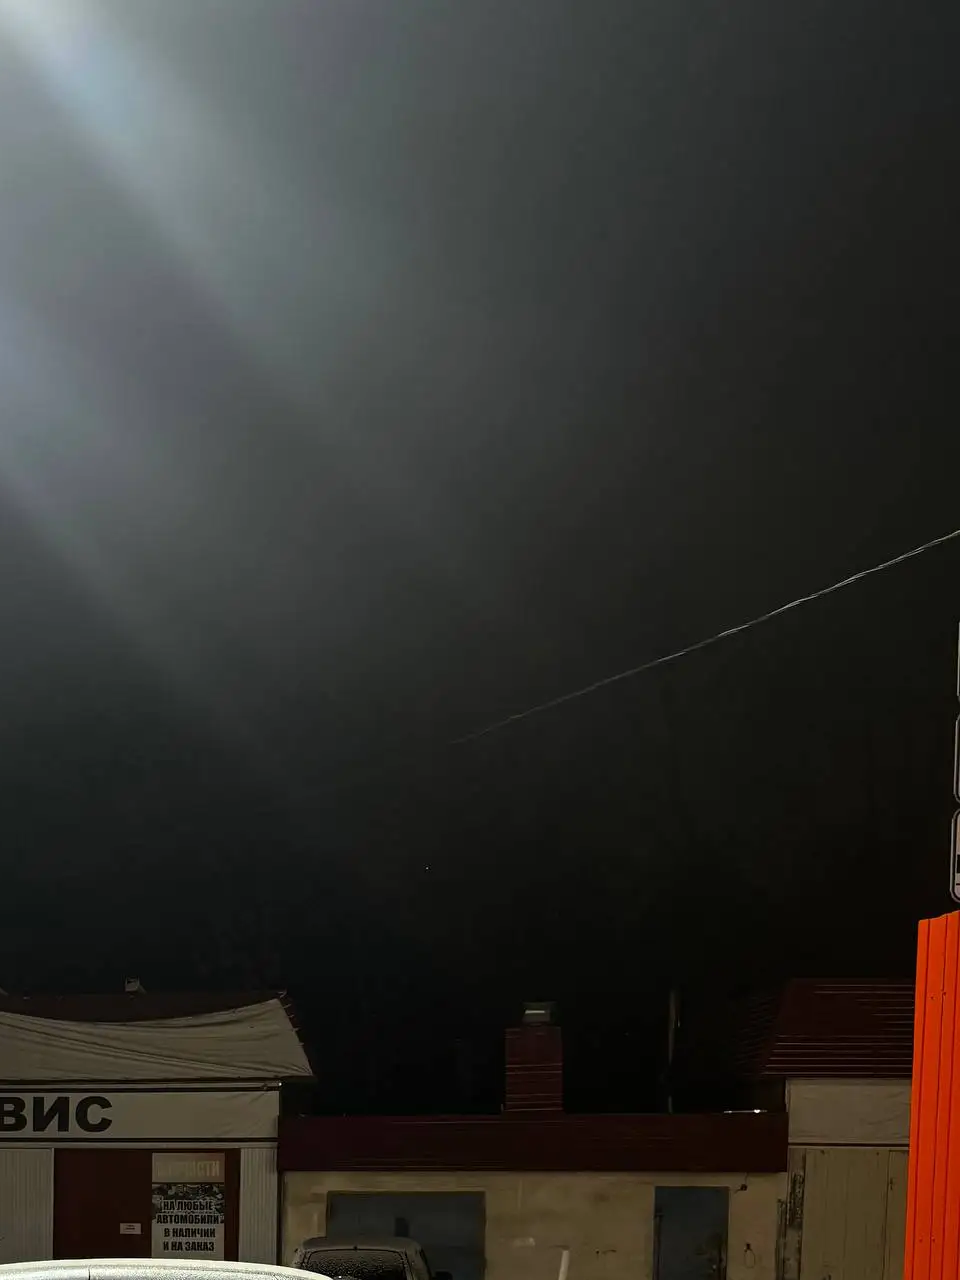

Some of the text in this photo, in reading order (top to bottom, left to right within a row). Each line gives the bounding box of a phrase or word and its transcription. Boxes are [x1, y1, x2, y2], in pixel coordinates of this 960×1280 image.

[163, 1199, 213, 1211] НА ЛЮБЫЕ
[156, 1214, 219, 1224] АВТОМОБИЛИ
[164, 1228, 216, 1238] В НАЛИЧИИ
[163, 1241, 215, 1252] И НА ЗАКАЗ
